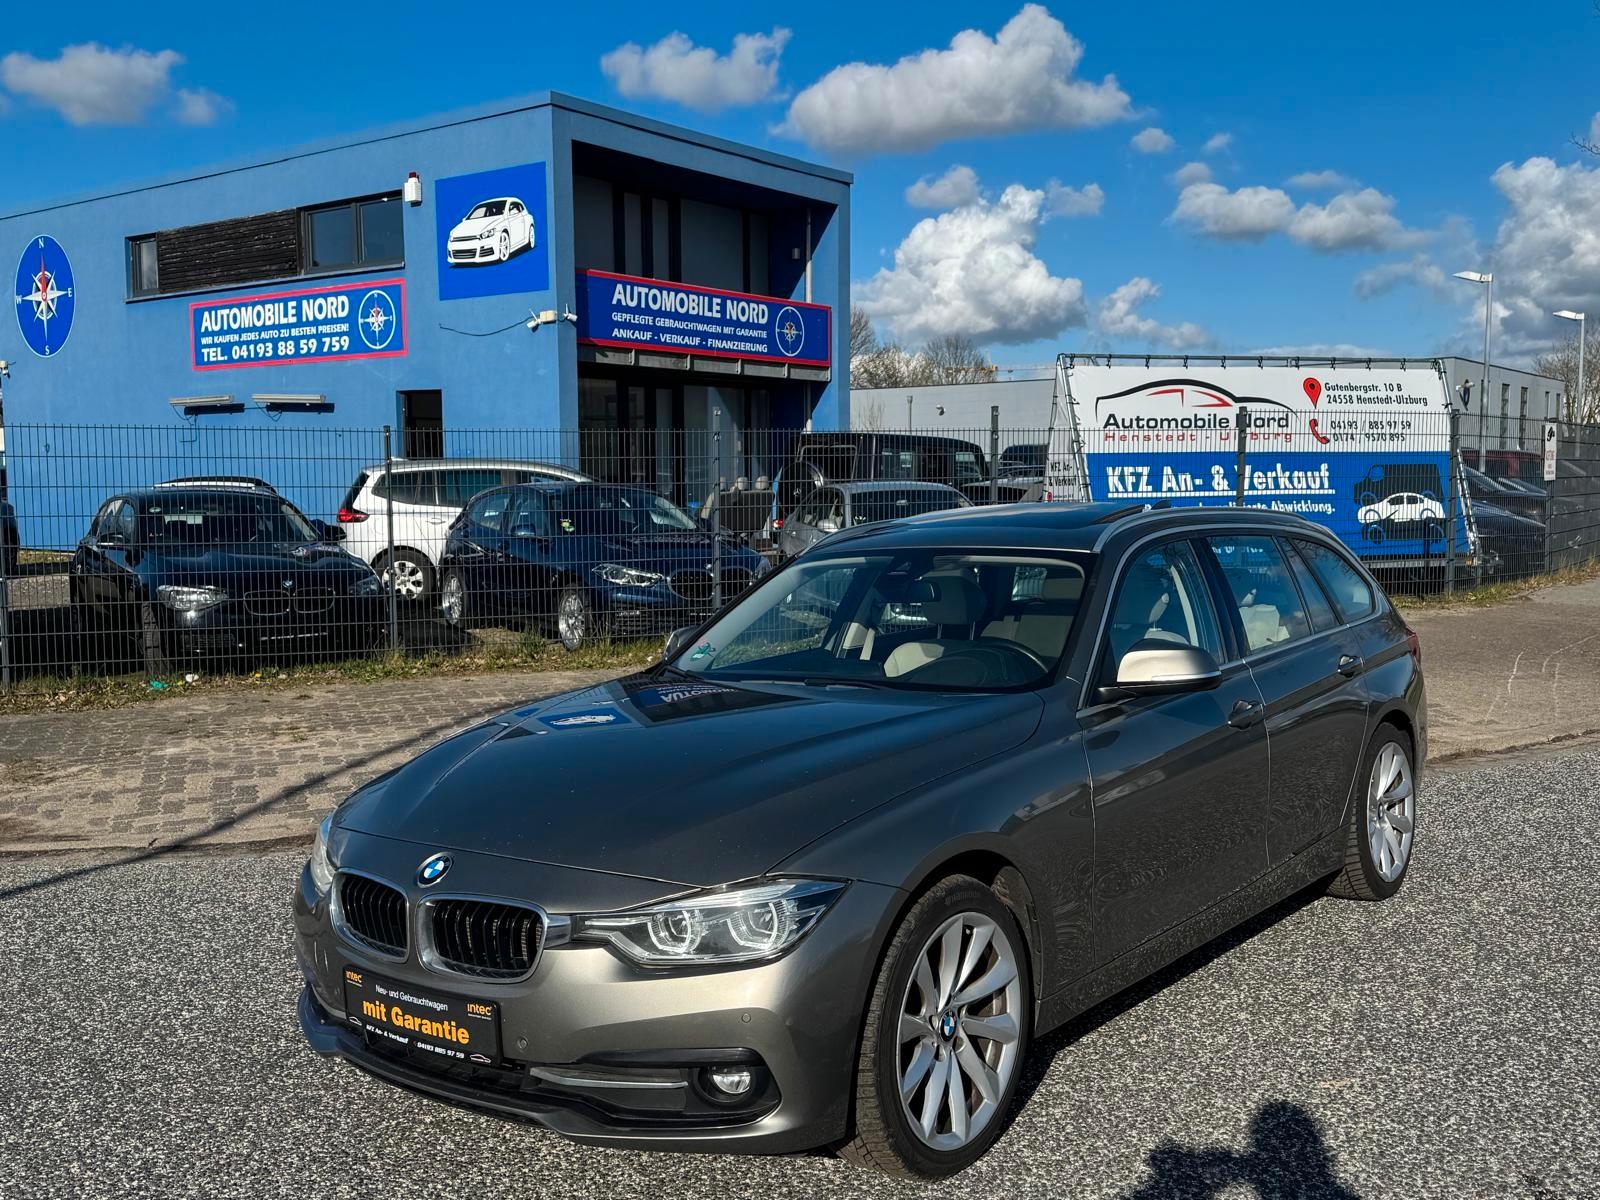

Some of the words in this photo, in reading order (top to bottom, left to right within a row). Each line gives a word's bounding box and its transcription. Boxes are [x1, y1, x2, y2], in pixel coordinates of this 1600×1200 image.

[38, 238, 45, 248] N
[67, 287, 73, 298] E
[611, 283, 721, 318] AUTOMOBILE
[726, 299, 769, 325] NORD
[201, 301, 297, 333] AUTOMOBILE
[302, 295, 349, 322] NORD
[611, 311, 653, 325] GEPFLEGTE
[655, 317, 722, 334] GEBRAUCHTWAGEN
[723, 326, 735, 335] MIT
[736, 327, 768, 339] GARANTIE
[201, 336, 212, 345] WIR
[214, 333, 239, 344] KAUFEN
[240, 332, 259, 341] JEDES
[260, 330, 279, 339] AUTO
[280, 329, 289, 338] ZU
[291, 326, 316, 336] BESTEN
[318, 323, 349, 334] PREISEN!
[611, 328, 653, 341] ANKAUF
[660, 333, 701, 346] VERKAUF
[708, 338, 768, 353] FINANZIERUNG
[44, 345, 50, 355] S
[201, 346, 227, 362] TEL.
[232, 342, 273, 360] 04193
[277, 340, 295, 356] 88
[300, 338, 317, 354] 59
[322, 335, 350, 352] 759
[1324, 382, 1381, 393] Gutenbergstr.
[1384, 383, 1395, 392] 10
[1396, 383, 1403, 392] B
[1326, 395, 1354, 405] 24558
[1356, 395, 1428, 406] Henstedt-Ulzburg
[1103, 413, 1230, 429] Automobile
[1331, 421, 1358, 430] 04193
[1368, 421, 1385, 430] 885
[1387, 421, 1397, 430] 97
[1401, 421, 1411, 430] 59
[1104, 432, 1196, 442] Henstedt
[1219, 431, 1292, 443] Ulburg
[1332, 432, 1354, 442] 0174
[1364, 432, 1387, 442] 9570
[1389, 432, 1405, 442] 895
[1106, 466, 1152, 493] KFZ
[1162, 465, 1203, 492] An-
[1211, 464, 1230, 490] &
[1271, 500, 1336, 515] Abwicklung.
[375, 984, 388, 995] Neu-
[389, 990, 399, 998] und
[399, 992, 448, 1011] Gebrauchtwagen
[467, 1003, 491, 1016] intec
[362, 1000, 387, 1022] mit
[391, 1006, 471, 1045] Garantie
[388, 1032, 409, 1044] Verkauf
[417, 1041, 434, 1051] 04193
[447, 1049, 455, 1057] 97
